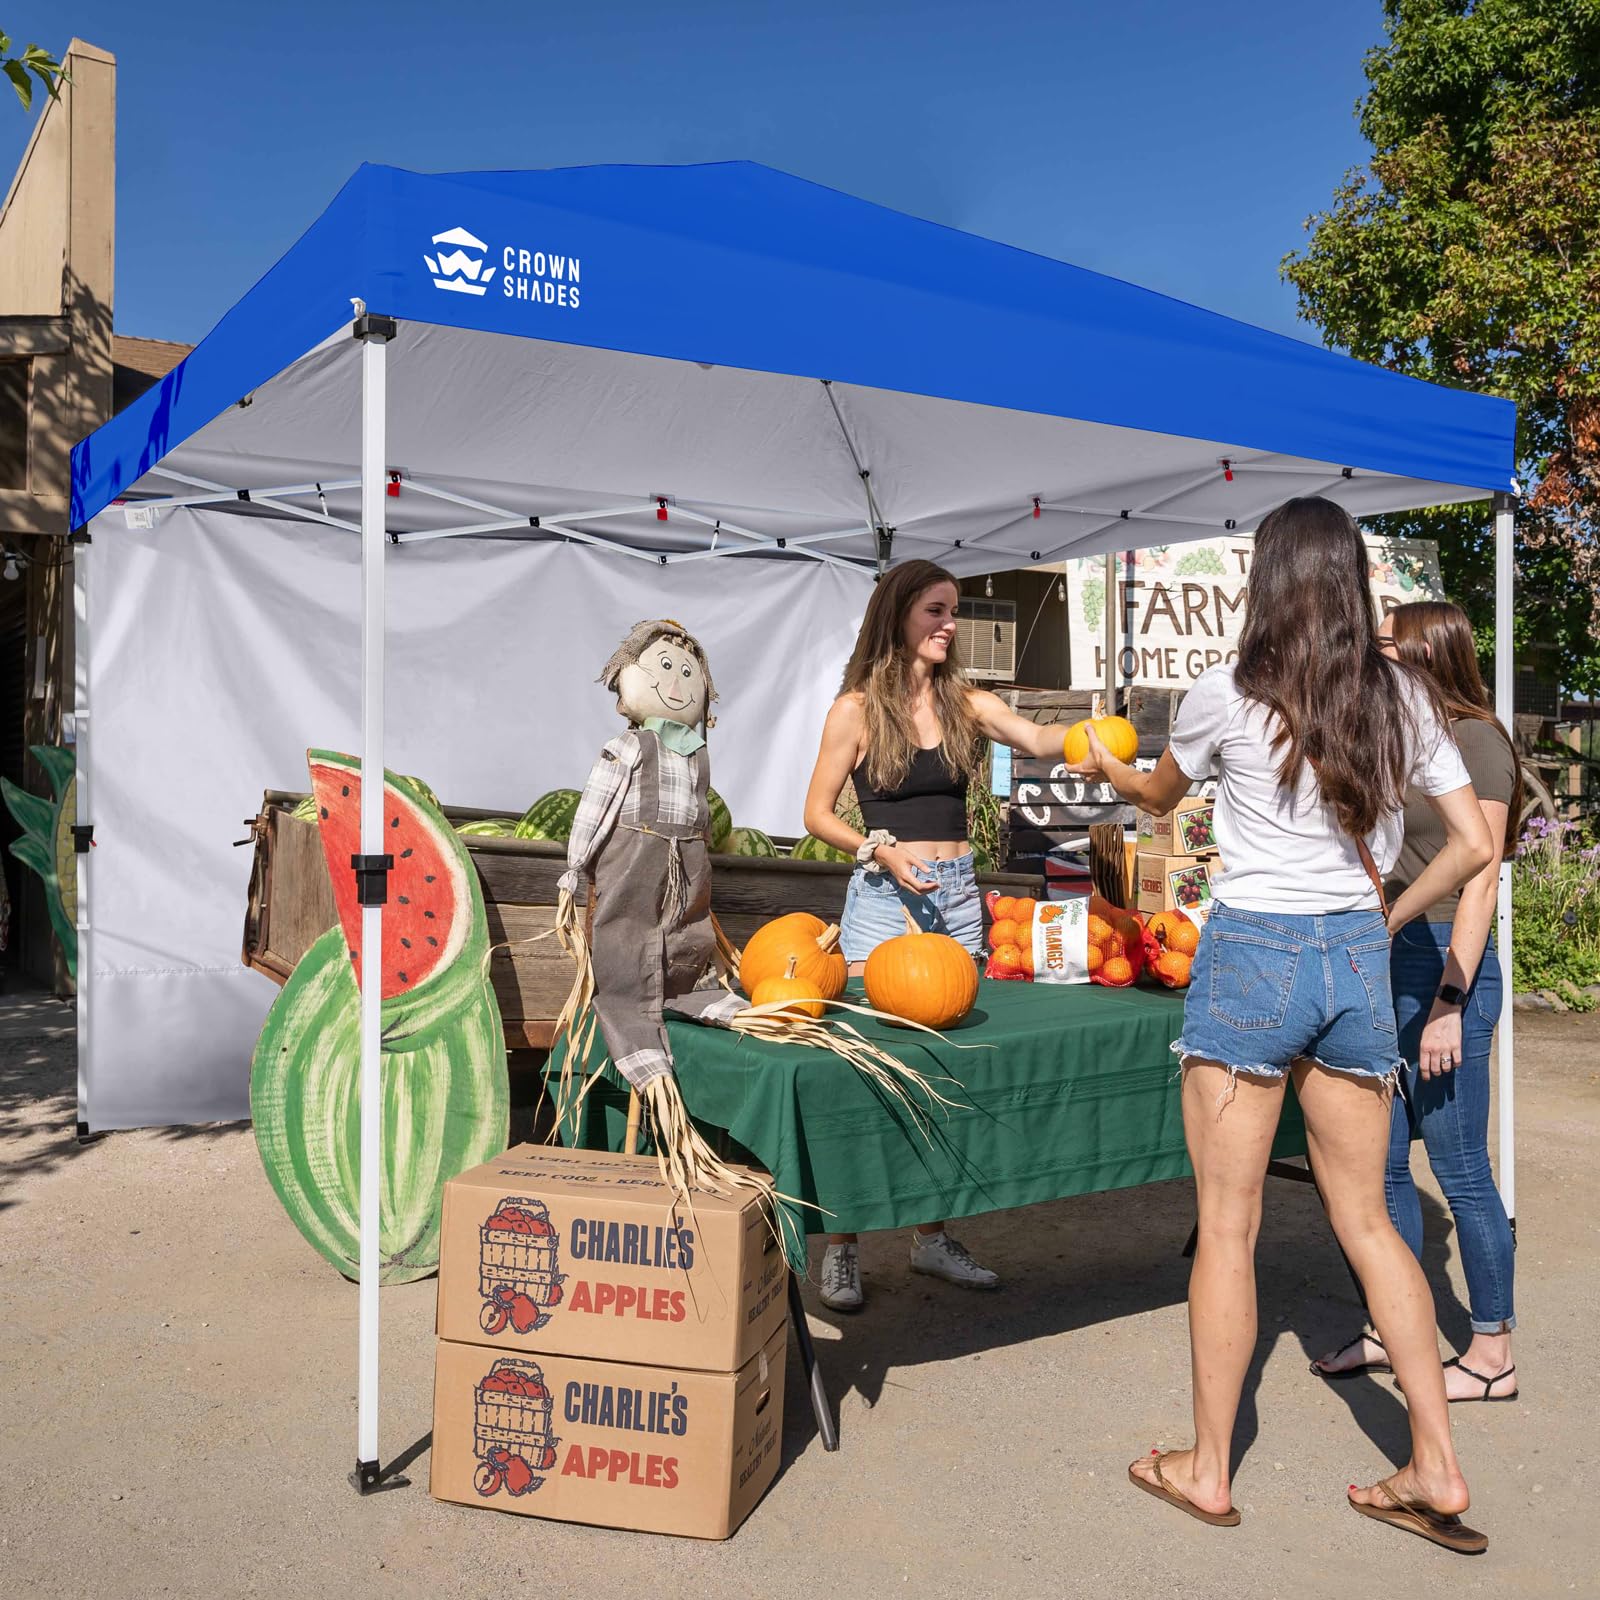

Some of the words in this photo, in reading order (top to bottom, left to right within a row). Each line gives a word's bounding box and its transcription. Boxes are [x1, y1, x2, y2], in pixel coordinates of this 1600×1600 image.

[503, 246, 581, 283] CROWN
[503, 275, 581, 309] SHADES
[1094, 646, 1179, 680] HOME
[1045, 925, 1064, 970] ORANGES
[498, 1168, 547, 1178] KEEP
[616, 1178, 665, 1188] KEEP
[569, 1216, 695, 1270] CHARLIE'S
[568, 1280, 686, 1322] APPLES
[564, 1381, 688, 1436] CHARLIE'S
[560, 1444, 680, 1489] APPLES
